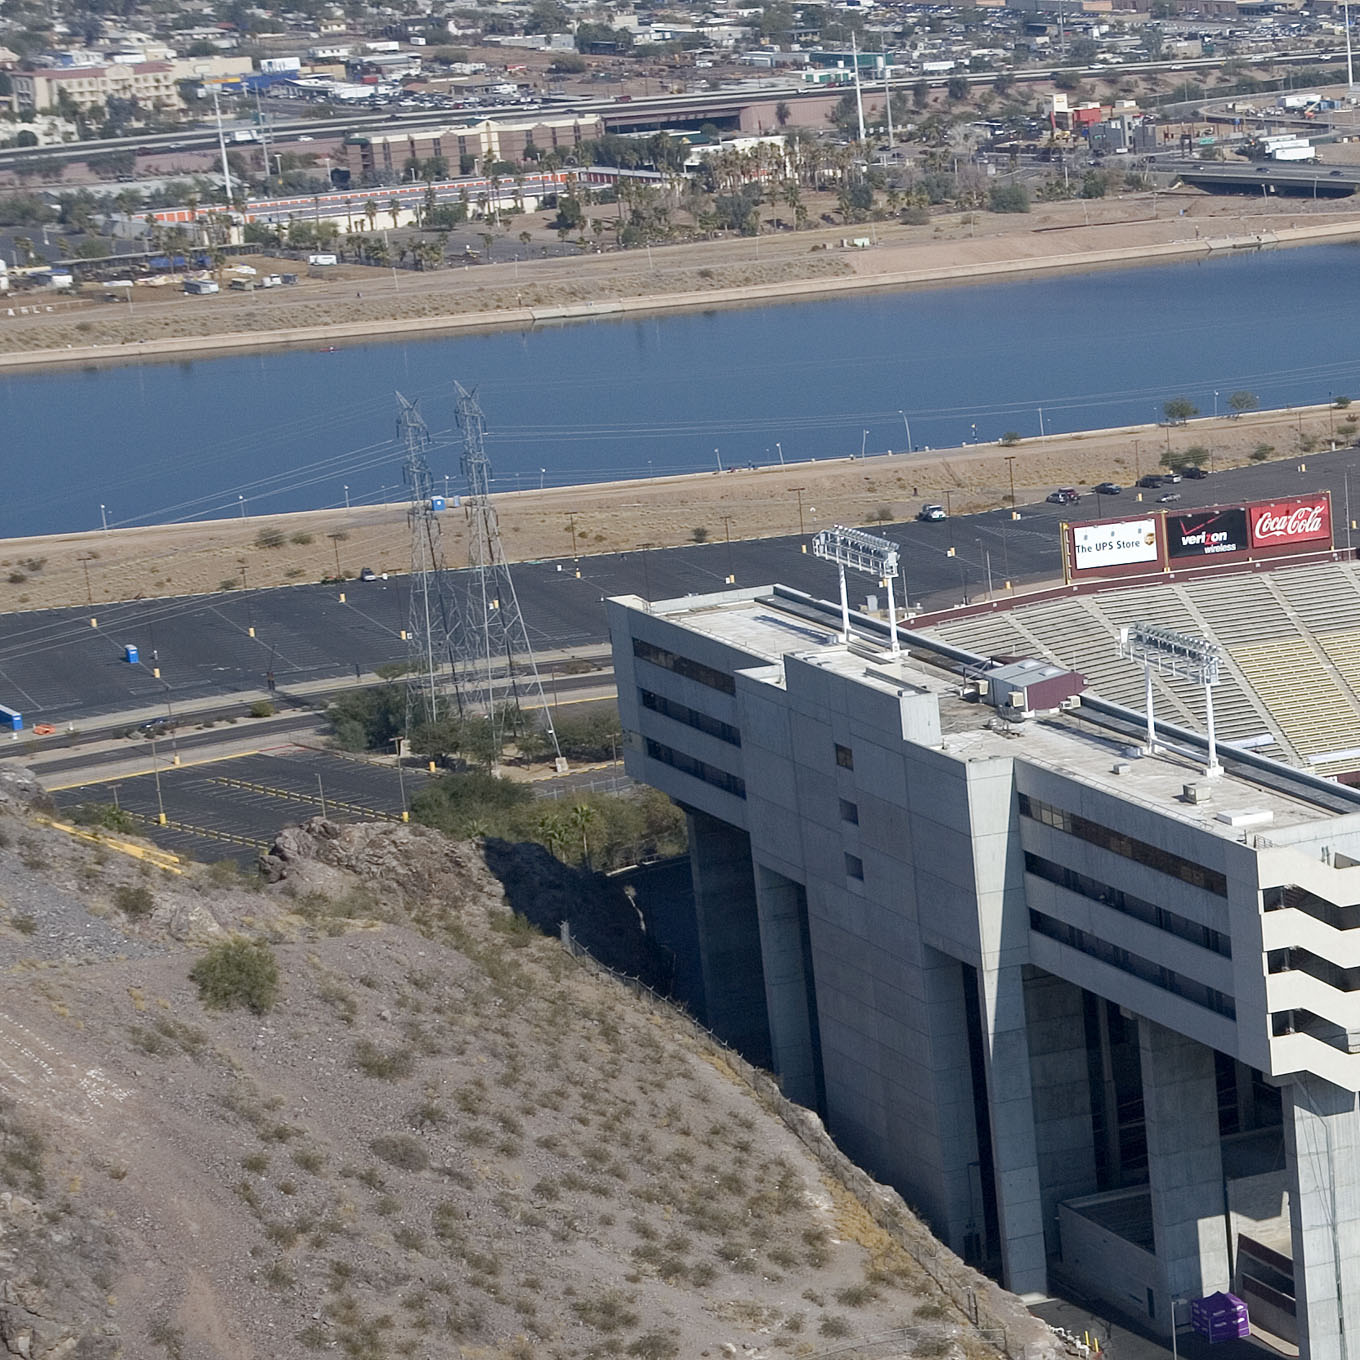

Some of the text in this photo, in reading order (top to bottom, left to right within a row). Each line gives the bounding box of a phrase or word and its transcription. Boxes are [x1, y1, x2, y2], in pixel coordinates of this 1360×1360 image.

[1255, 505, 1325, 540] Coca-Cola
[1075, 538, 1141, 554] The UPS Store
[1181, 530, 1228, 546] verizon
[1204, 543, 1236, 554] wireless
